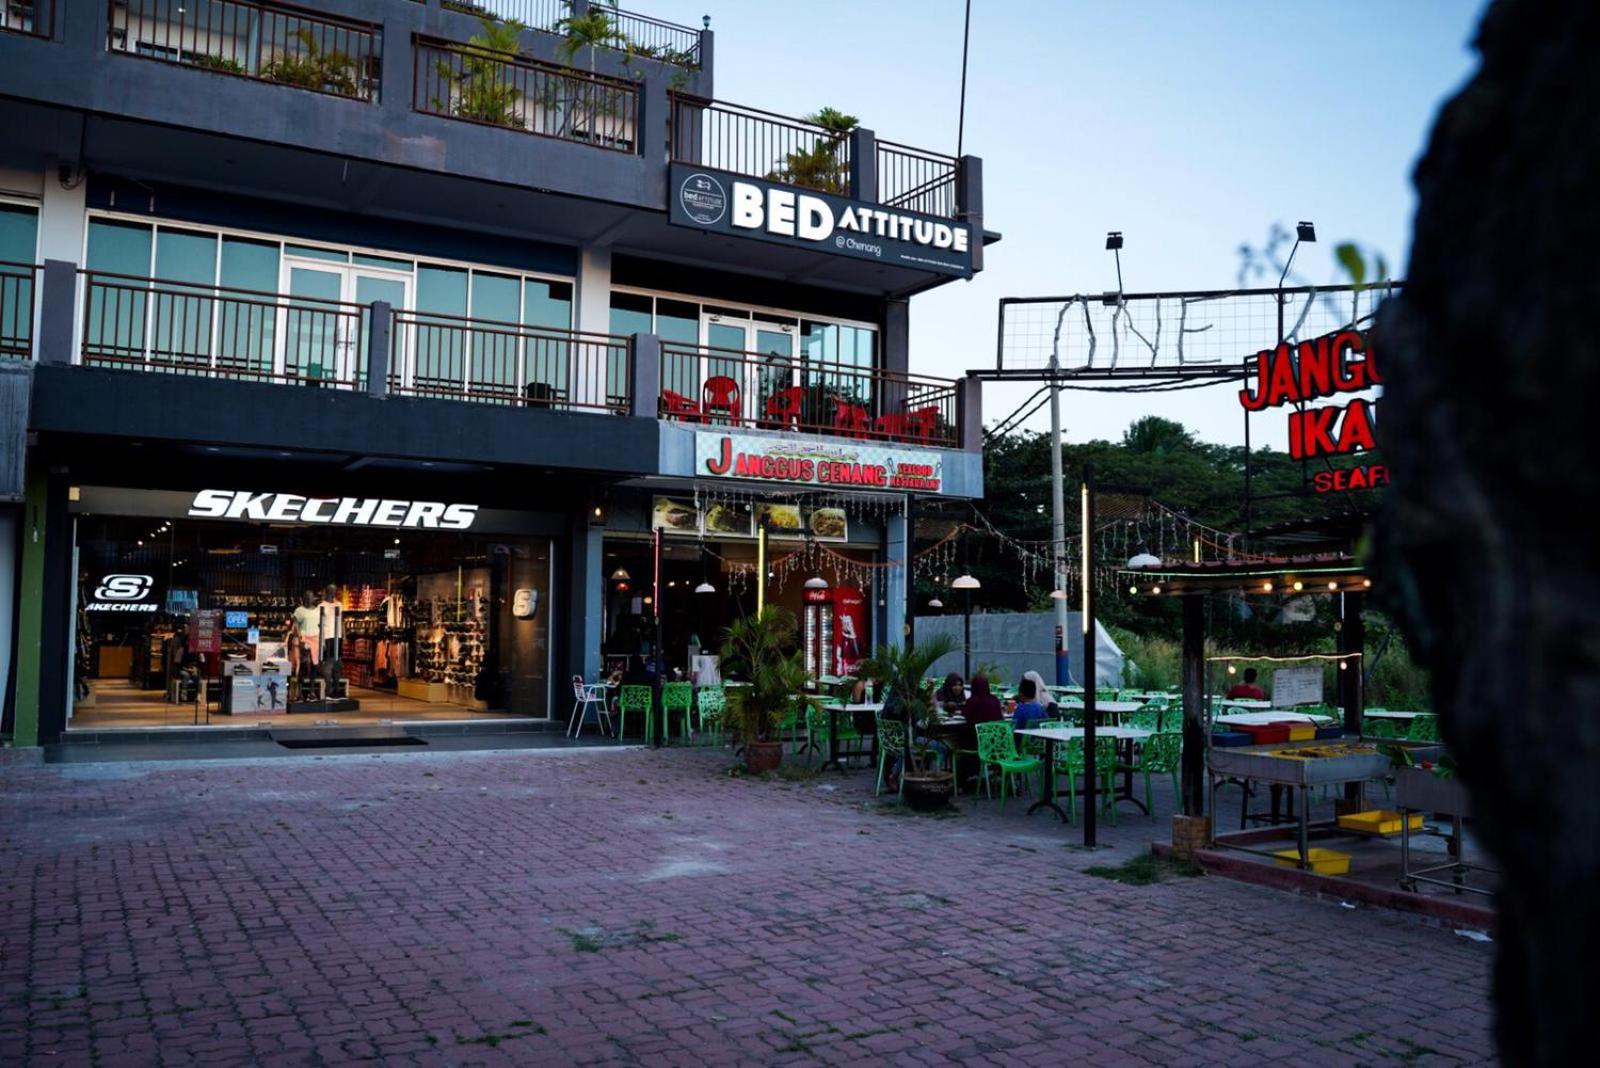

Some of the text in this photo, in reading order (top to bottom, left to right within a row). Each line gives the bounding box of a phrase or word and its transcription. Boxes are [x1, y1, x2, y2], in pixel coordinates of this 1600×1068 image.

[732, 181, 969, 252] BED ATTITUDE
[846, 238, 881, 257] Chenang
[706, 437, 815, 481] JANGGUS
[817, 460, 887, 487] CENANG
[188, 489, 479, 530] SKECHERS
